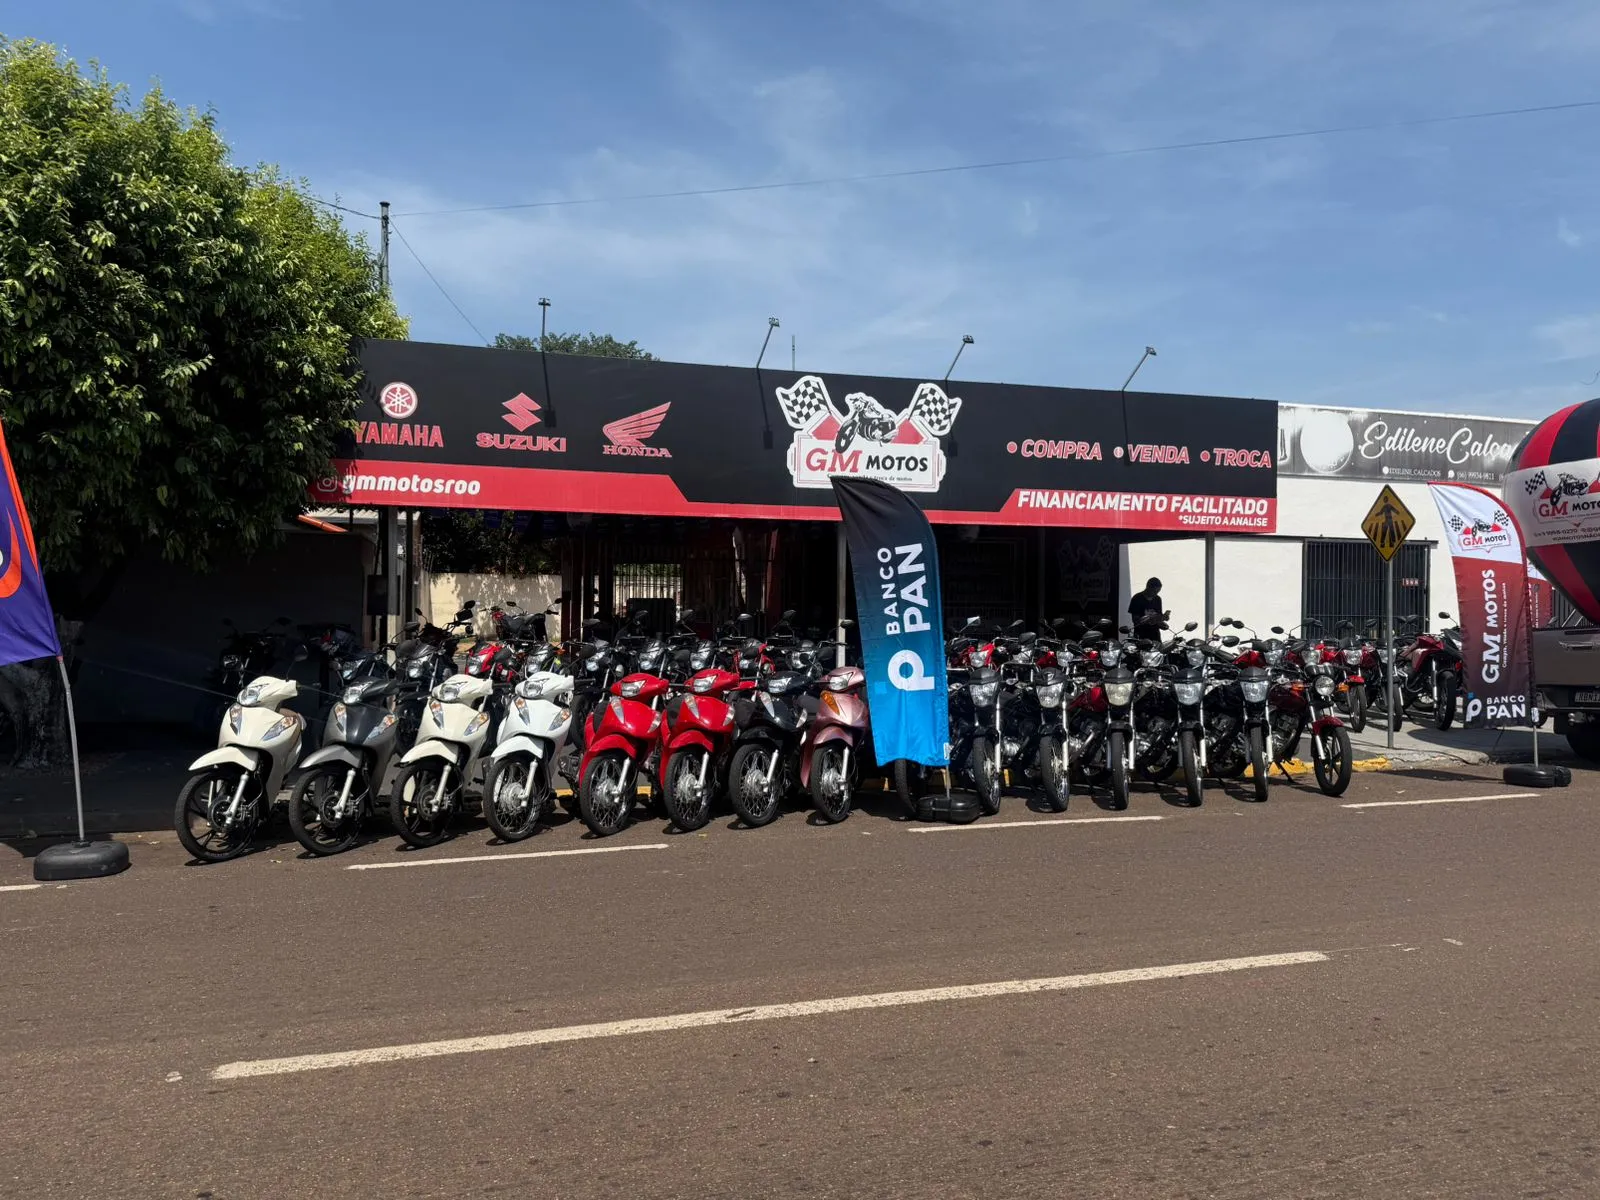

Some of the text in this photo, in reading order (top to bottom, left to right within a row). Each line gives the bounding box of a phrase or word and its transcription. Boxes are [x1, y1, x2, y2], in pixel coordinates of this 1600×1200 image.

[354, 420, 444, 448] YAMAHA
[475, 432, 567, 452] SUZUKI
[1358, 420, 1448, 459] Edilene
[602, 444, 673, 458] HONDA
[805, 447, 928, 473] GM MOTOS
[1020, 438, 1103, 461] COMPRA
[1127, 443, 1190, 464] VENDA
[1212, 447, 1272, 468] TROCA
[342, 474, 481, 496] gmmotosroo
[1017, 490, 1268, 516] FINANCIAMENTO FACILITADO
[1539, 501, 1569, 517] GM
[1222, 517, 1229, 525] A
[1462, 536, 1483, 546] GM
[1484, 535, 1507, 543] MOTOS
[877, 547, 901, 635] BANCO
[894, 543, 931, 634] PAN
[1481, 569, 1499, 628] MOTOS
[1481, 632, 1501, 684] GM
[1486, 695, 1525, 705] BANCO
[1486, 704, 1526, 719] PAN
